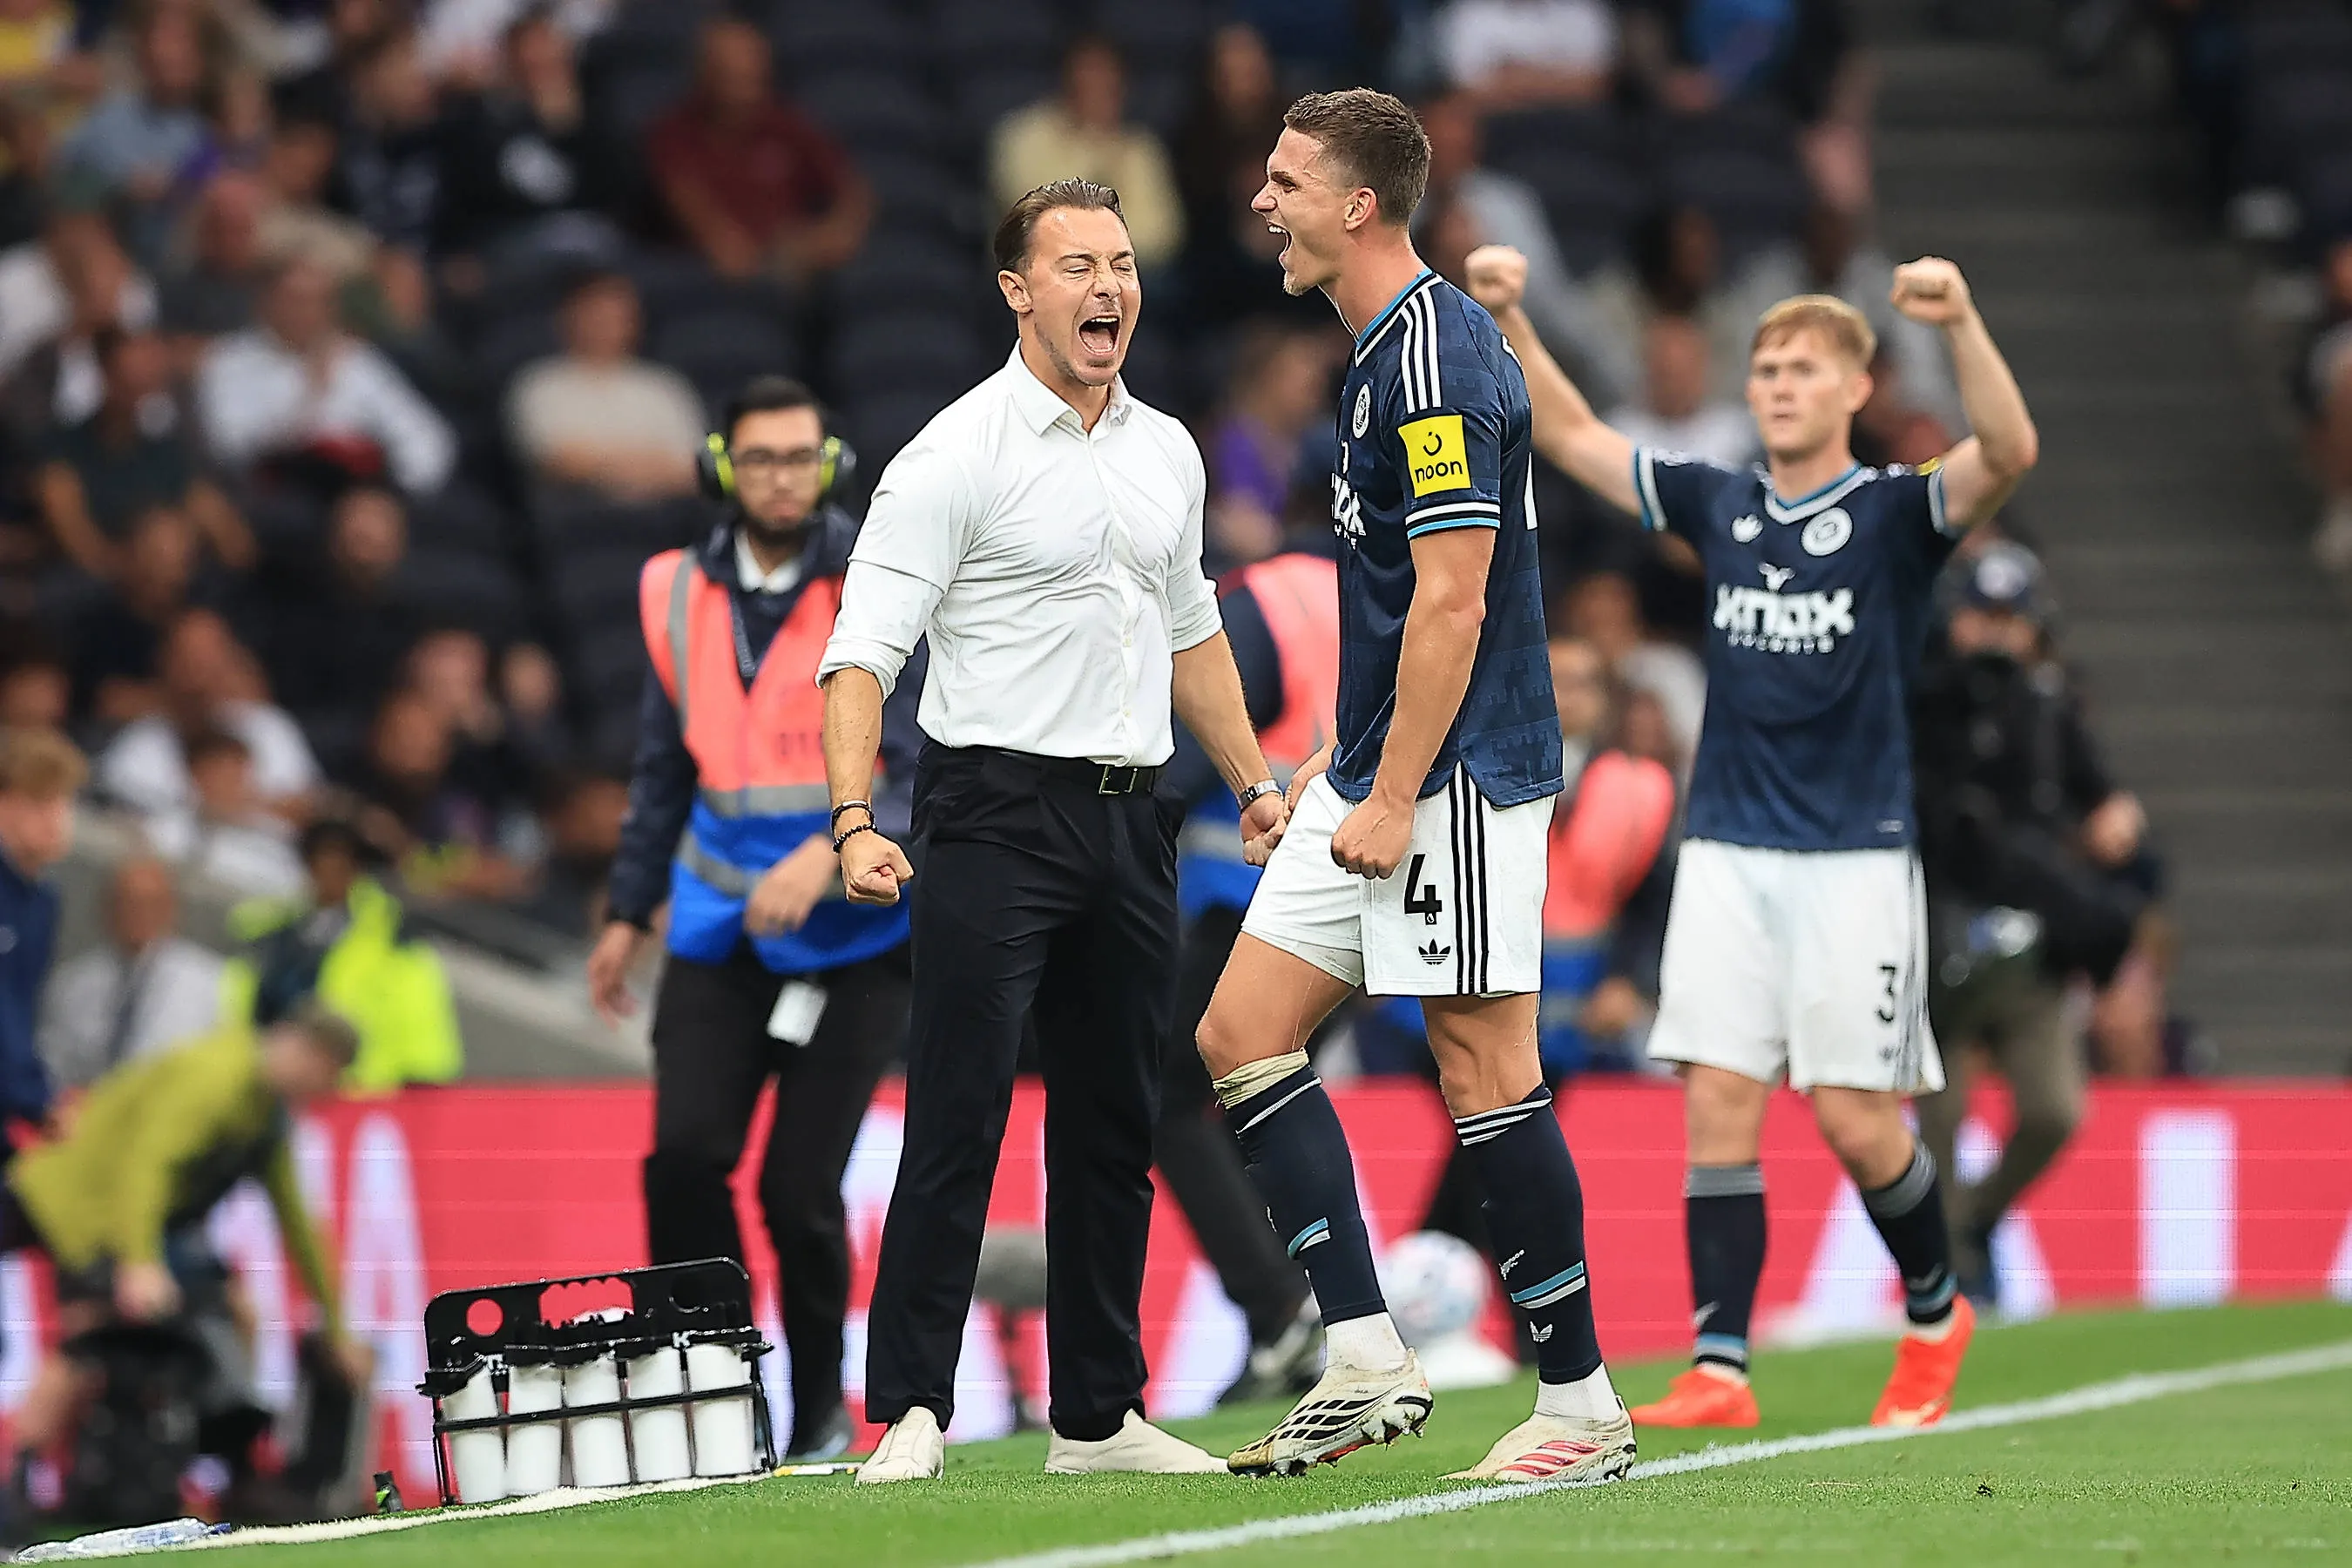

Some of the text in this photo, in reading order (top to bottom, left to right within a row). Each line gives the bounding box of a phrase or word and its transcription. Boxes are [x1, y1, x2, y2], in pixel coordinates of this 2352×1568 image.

[1414, 460, 1463, 483] noon
[1403, 853, 1443, 926] 4
[1874, 963, 1897, 1023] 3
